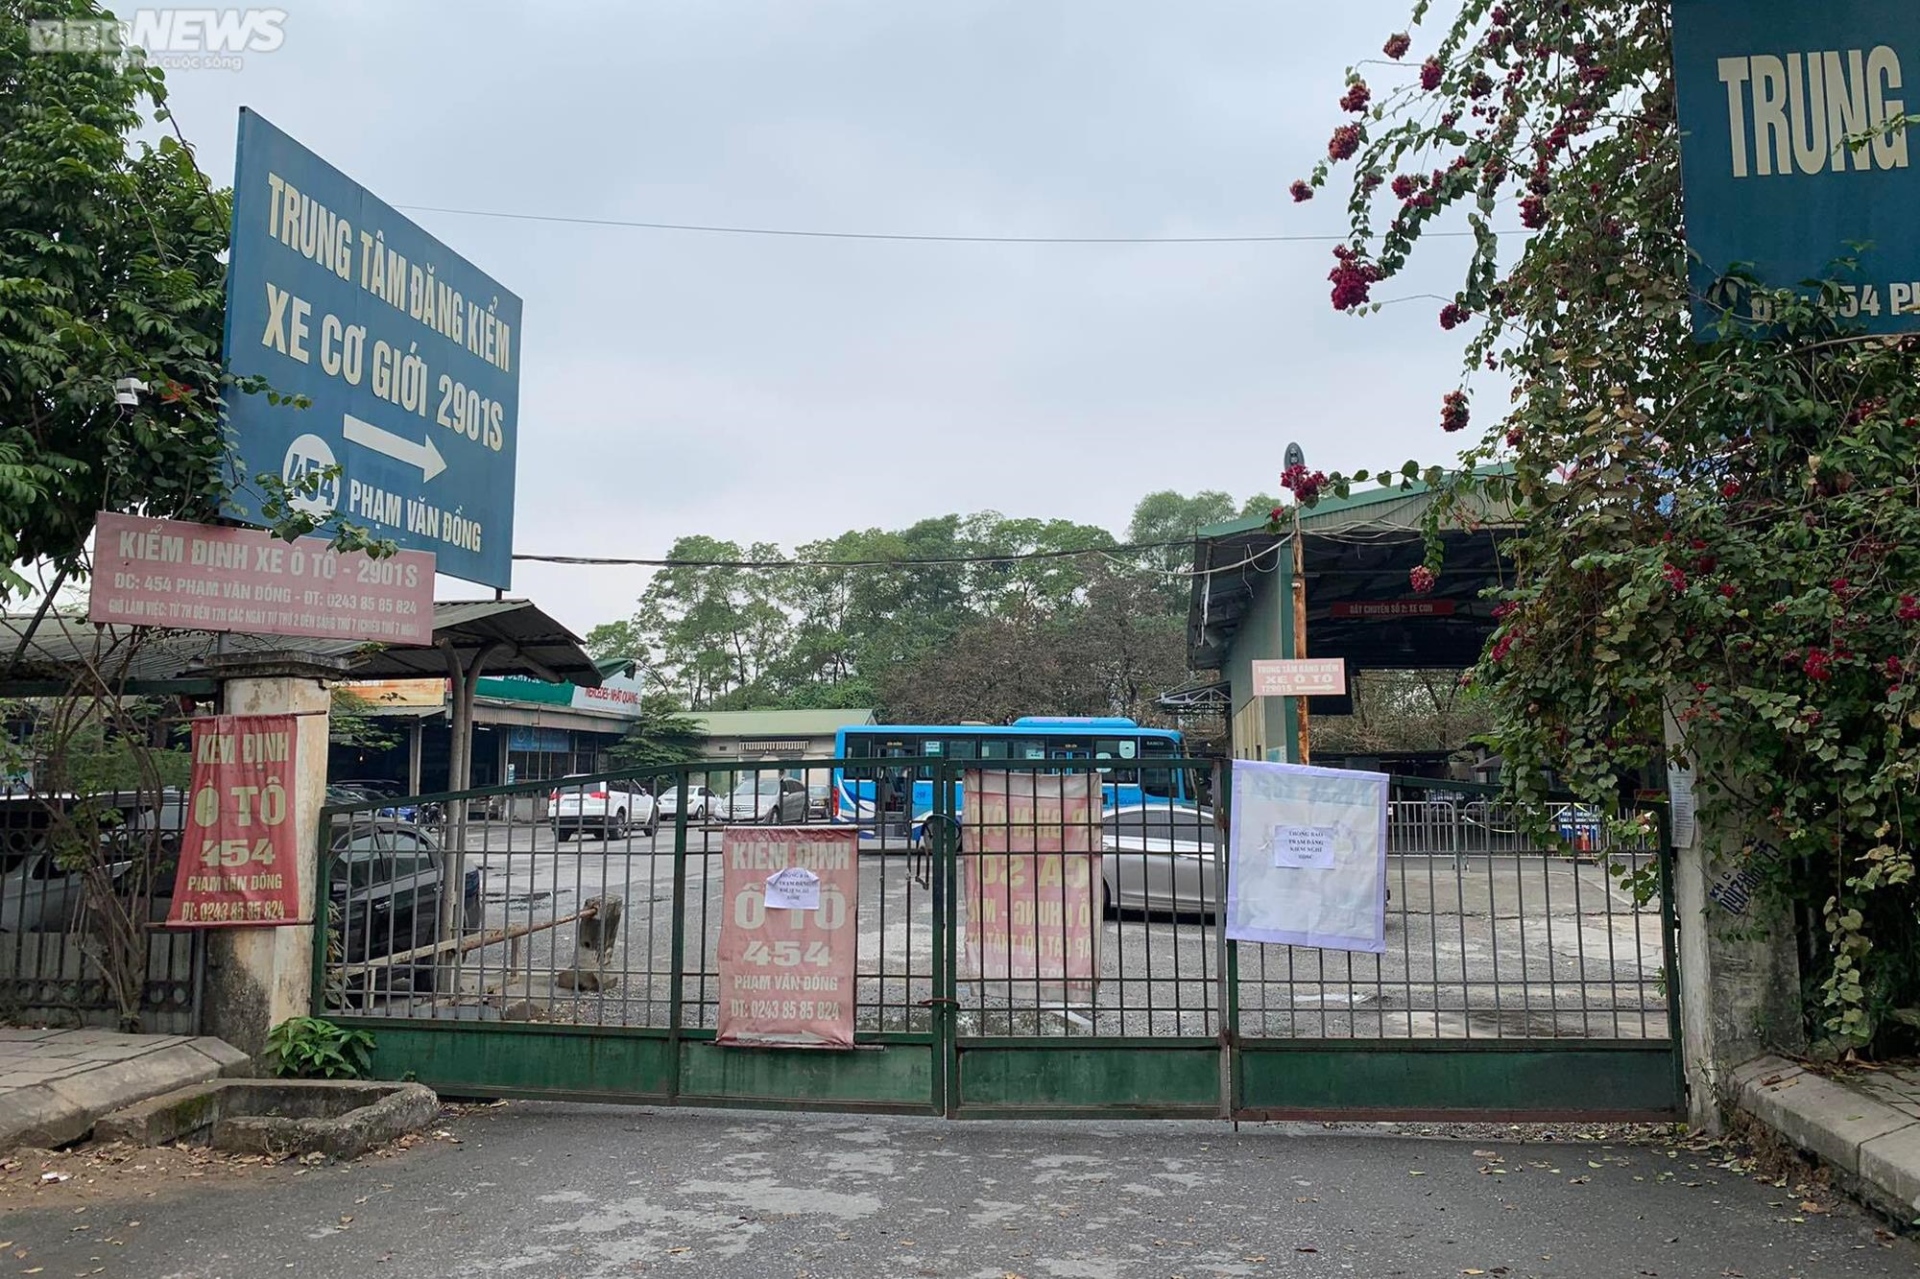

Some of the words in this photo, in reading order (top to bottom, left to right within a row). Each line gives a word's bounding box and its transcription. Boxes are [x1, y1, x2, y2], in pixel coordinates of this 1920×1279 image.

[1717, 45, 1909, 178] TRUNG
[268, 171, 352, 281] TRUNG
[360, 229, 407, 312] TÂM
[410, 262, 463, 346] ĐĂNG
[467, 295, 510, 373] KIỂM
[261, 281, 312, 365] XE
[320, 314, 367, 386] CƠ
[372, 341, 428, 417] GIỚI
[436, 374, 504, 452] 2901S
[349, 479, 402, 530] PHẠM
[407, 499, 439, 538] VĂN
[442, 505, 482, 552] ĐỒNG
[119, 524, 184, 563] KIỂM
[191, 540, 249, 572] ĐỊNH
[254, 547, 284, 573] XE
[290, 544, 305, 576] Ô
[311, 549, 338, 580] TÔ
[357, 559, 418, 588] 2901S
[144, 576, 171, 592] 454
[176, 578, 218, 598] PHẠM
[223, 580, 251, 600] VĂN
[360, 596, 375, 612] 85
[378, 597, 392, 613] 85
[1265, 675, 1288, 684] XE
[243, 732, 290, 770] ĐỊNH
[194, 779, 220, 828] Ô
[231, 776, 287, 828] TÔ
[201, 838, 276, 867] 454
[735, 883, 766, 930] Ô
[743, 941, 832, 967] 454
[735, 974, 771, 993] PHẠM
[751, 1000, 779, 1019] 0243
[782, 1001, 796, 1019] 85
[799, 1001, 814, 1019] 85
[817, 1001, 840, 1020] 824
